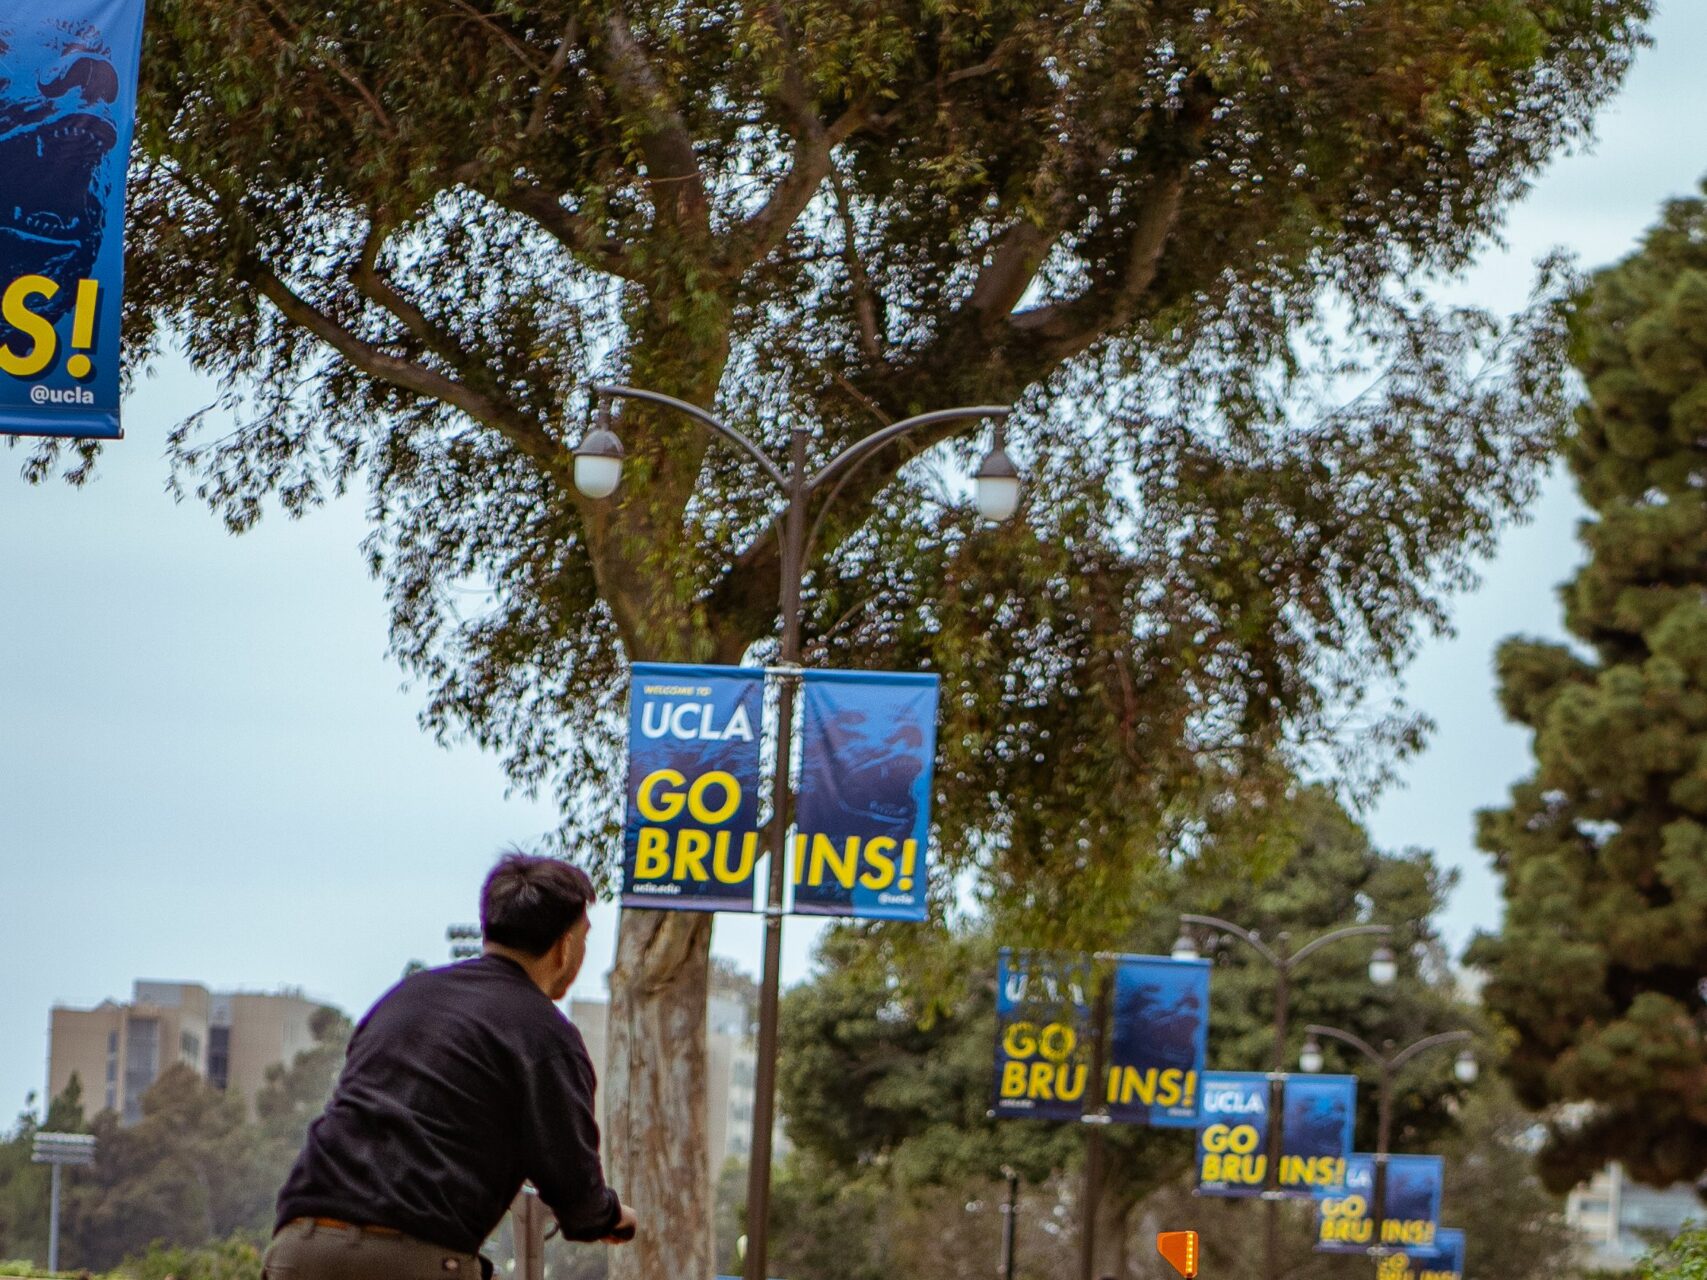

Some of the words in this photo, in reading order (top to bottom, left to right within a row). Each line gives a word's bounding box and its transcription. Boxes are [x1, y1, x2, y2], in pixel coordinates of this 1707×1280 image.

[0, 274, 99, 378] S!
[30, 385, 94, 404] @ucla
[644, 685, 694, 696] WELCOME
[641, 702, 754, 742] UCLA
[636, 769, 742, 824] GO
[634, 827, 759, 884] BRU
[793, 832, 918, 891] INS!
[1002, 1021, 1077, 1061] GO
[1001, 1061, 1088, 1102] BRU
[1107, 1065, 1198, 1107] INS!
[1203, 1090, 1265, 1114] UCLA
[1202, 1124, 1259, 1154] GO
[1201, 1153, 1268, 1184] BRU
[1279, 1155, 1347, 1186] INS!
[1346, 1168, 1373, 1188] LA
[1319, 1217, 1373, 1243] BRU
[1381, 1219, 1437, 1245] INS!
